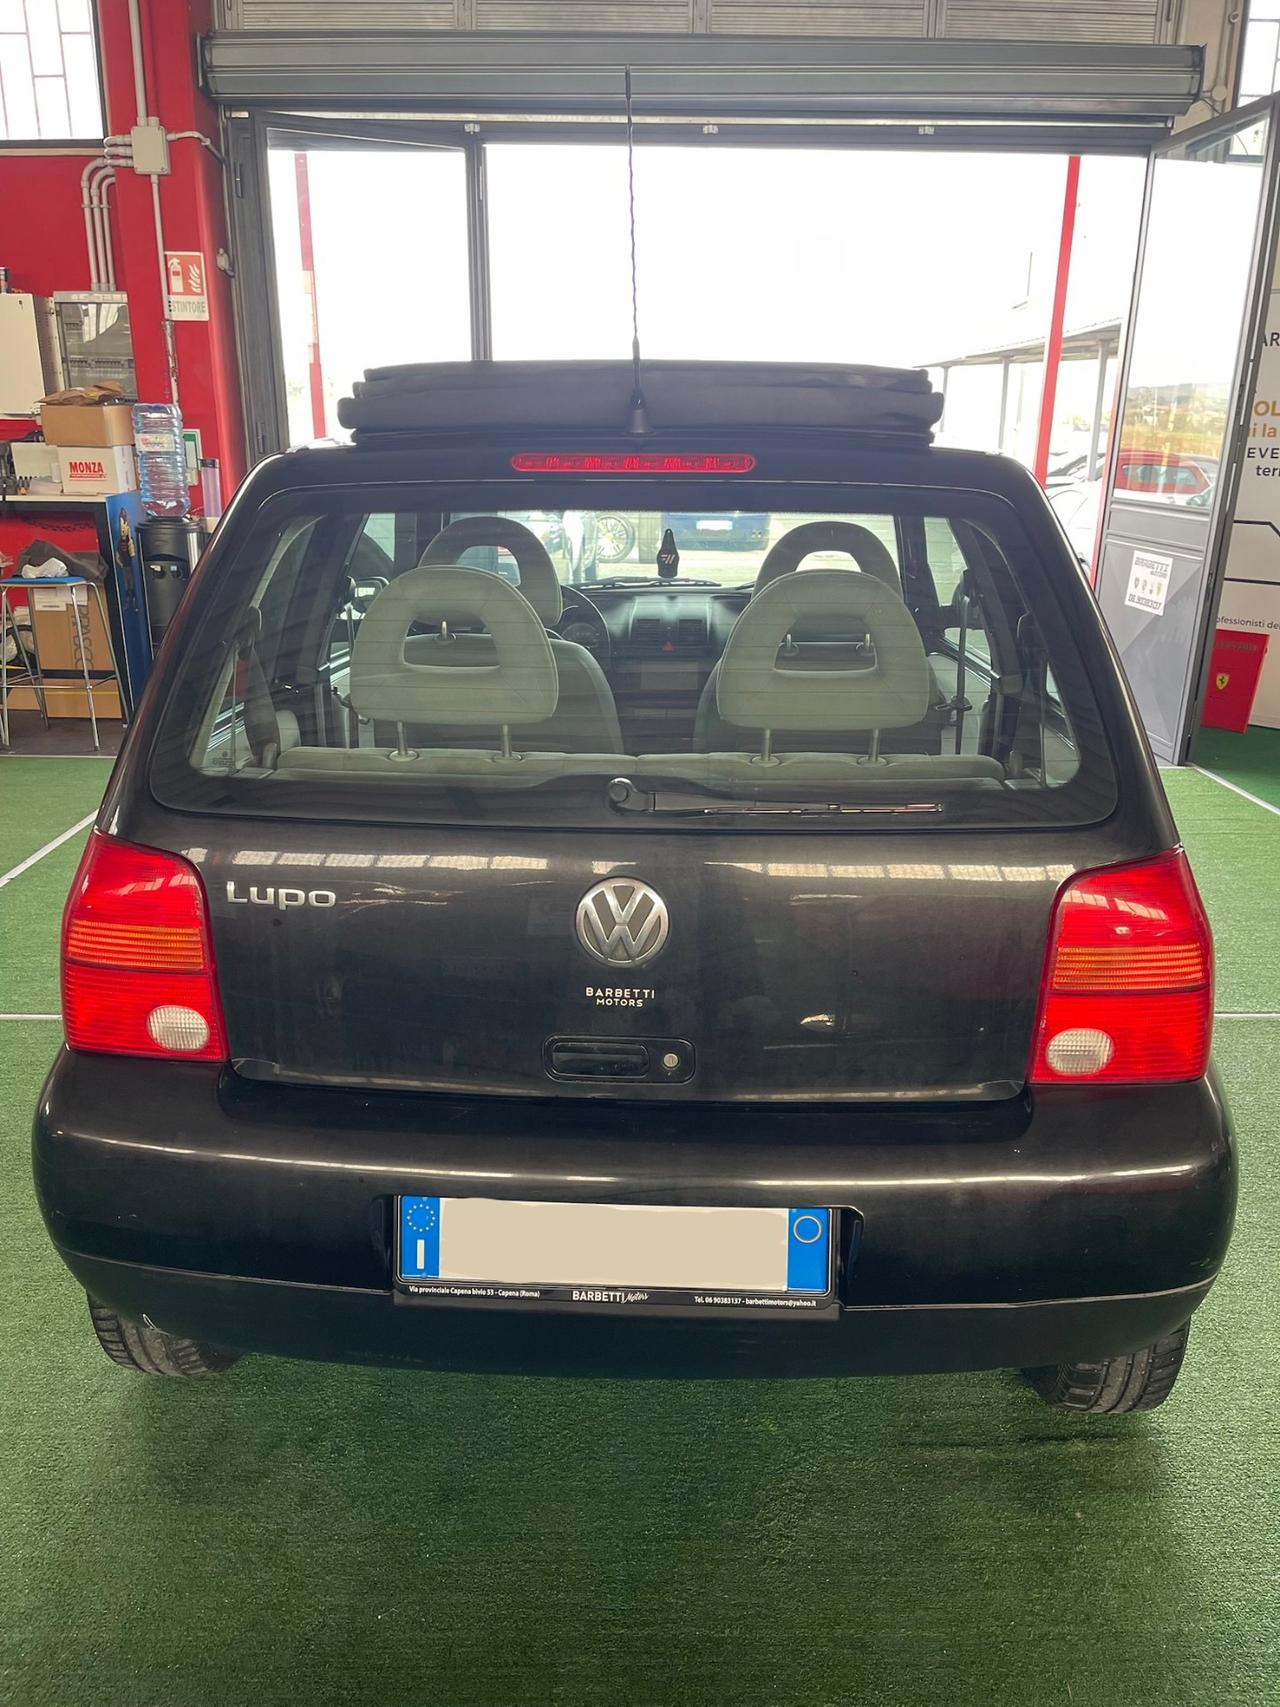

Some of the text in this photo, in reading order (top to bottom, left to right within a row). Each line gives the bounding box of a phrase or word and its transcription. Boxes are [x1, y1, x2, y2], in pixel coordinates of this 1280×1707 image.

[69, 461, 104, 474] MONZA
[1256, 464, 1280, 477] ter
[226, 881, 336, 910] Lupo
[585, 986, 655, 999] BARBETTI
[596, 998, 644, 1007] MOTORS
[408, 1285, 419, 1293] Via
[419, 1286, 450, 1295] provinciale
[450, 1287, 472, 1296] Capena
[498, 1289, 520, 1298] Capena
[520, 1290, 541, 1299] (Roma)
[572, 1290, 625, 1302] BARBETTI
